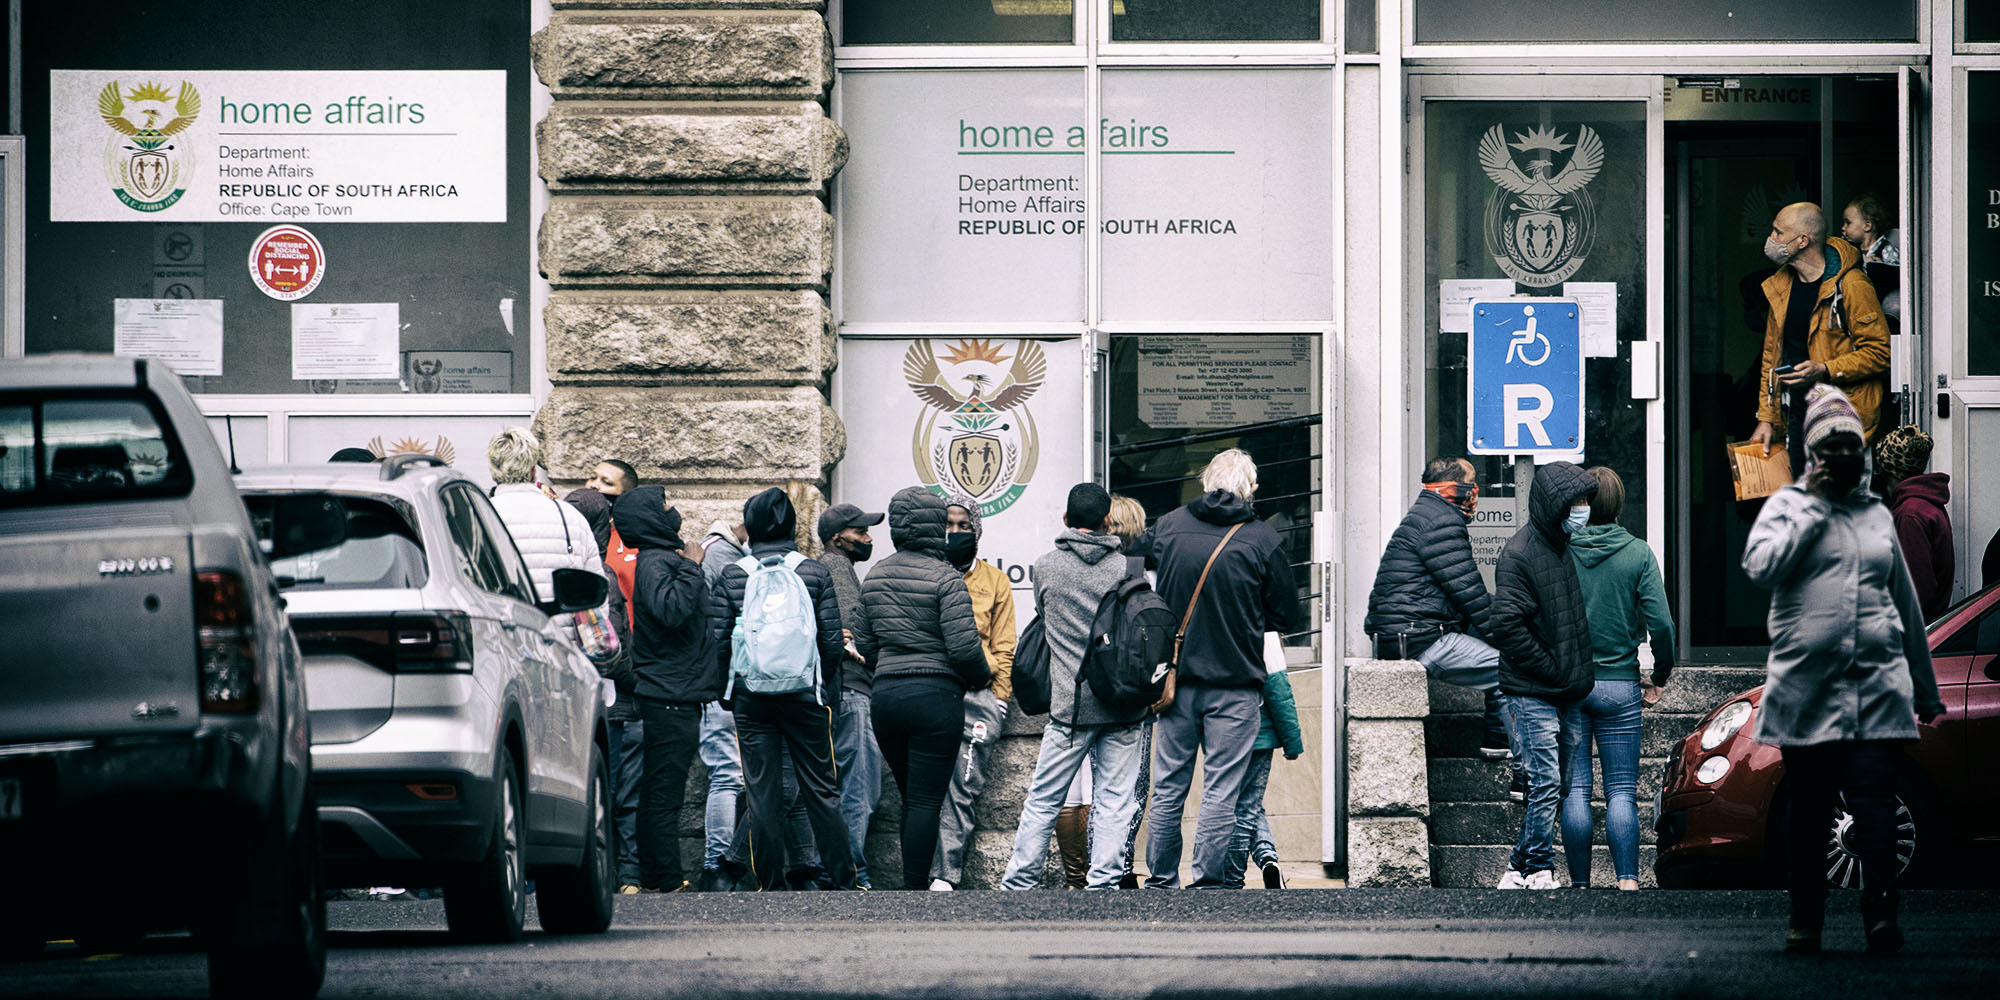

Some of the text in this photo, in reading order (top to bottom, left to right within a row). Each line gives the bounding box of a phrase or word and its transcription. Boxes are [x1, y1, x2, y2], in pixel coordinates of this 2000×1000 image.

[1702, 88, 1811, 102] ENTRANCE
[220, 96, 426, 124] home affairs
[959, 118, 1169, 148] home afairs
[219, 145, 310, 161] Department:
[219, 164, 314, 178] Home Affairs
[219, 184, 459, 198] REPUBLIC OF SOUTH AFRICA
[958, 174, 1079, 194] Department:
[219, 202, 352, 218] Office: Cape Town
[958, 196, 1085, 214] Home Affairs
[958, 220, 1055, 235] REPUBLIC
[1164, 219, 1236, 234] AFRICA
[1504, 384, 1554, 447] R
[1473, 510, 1512, 522] ome
